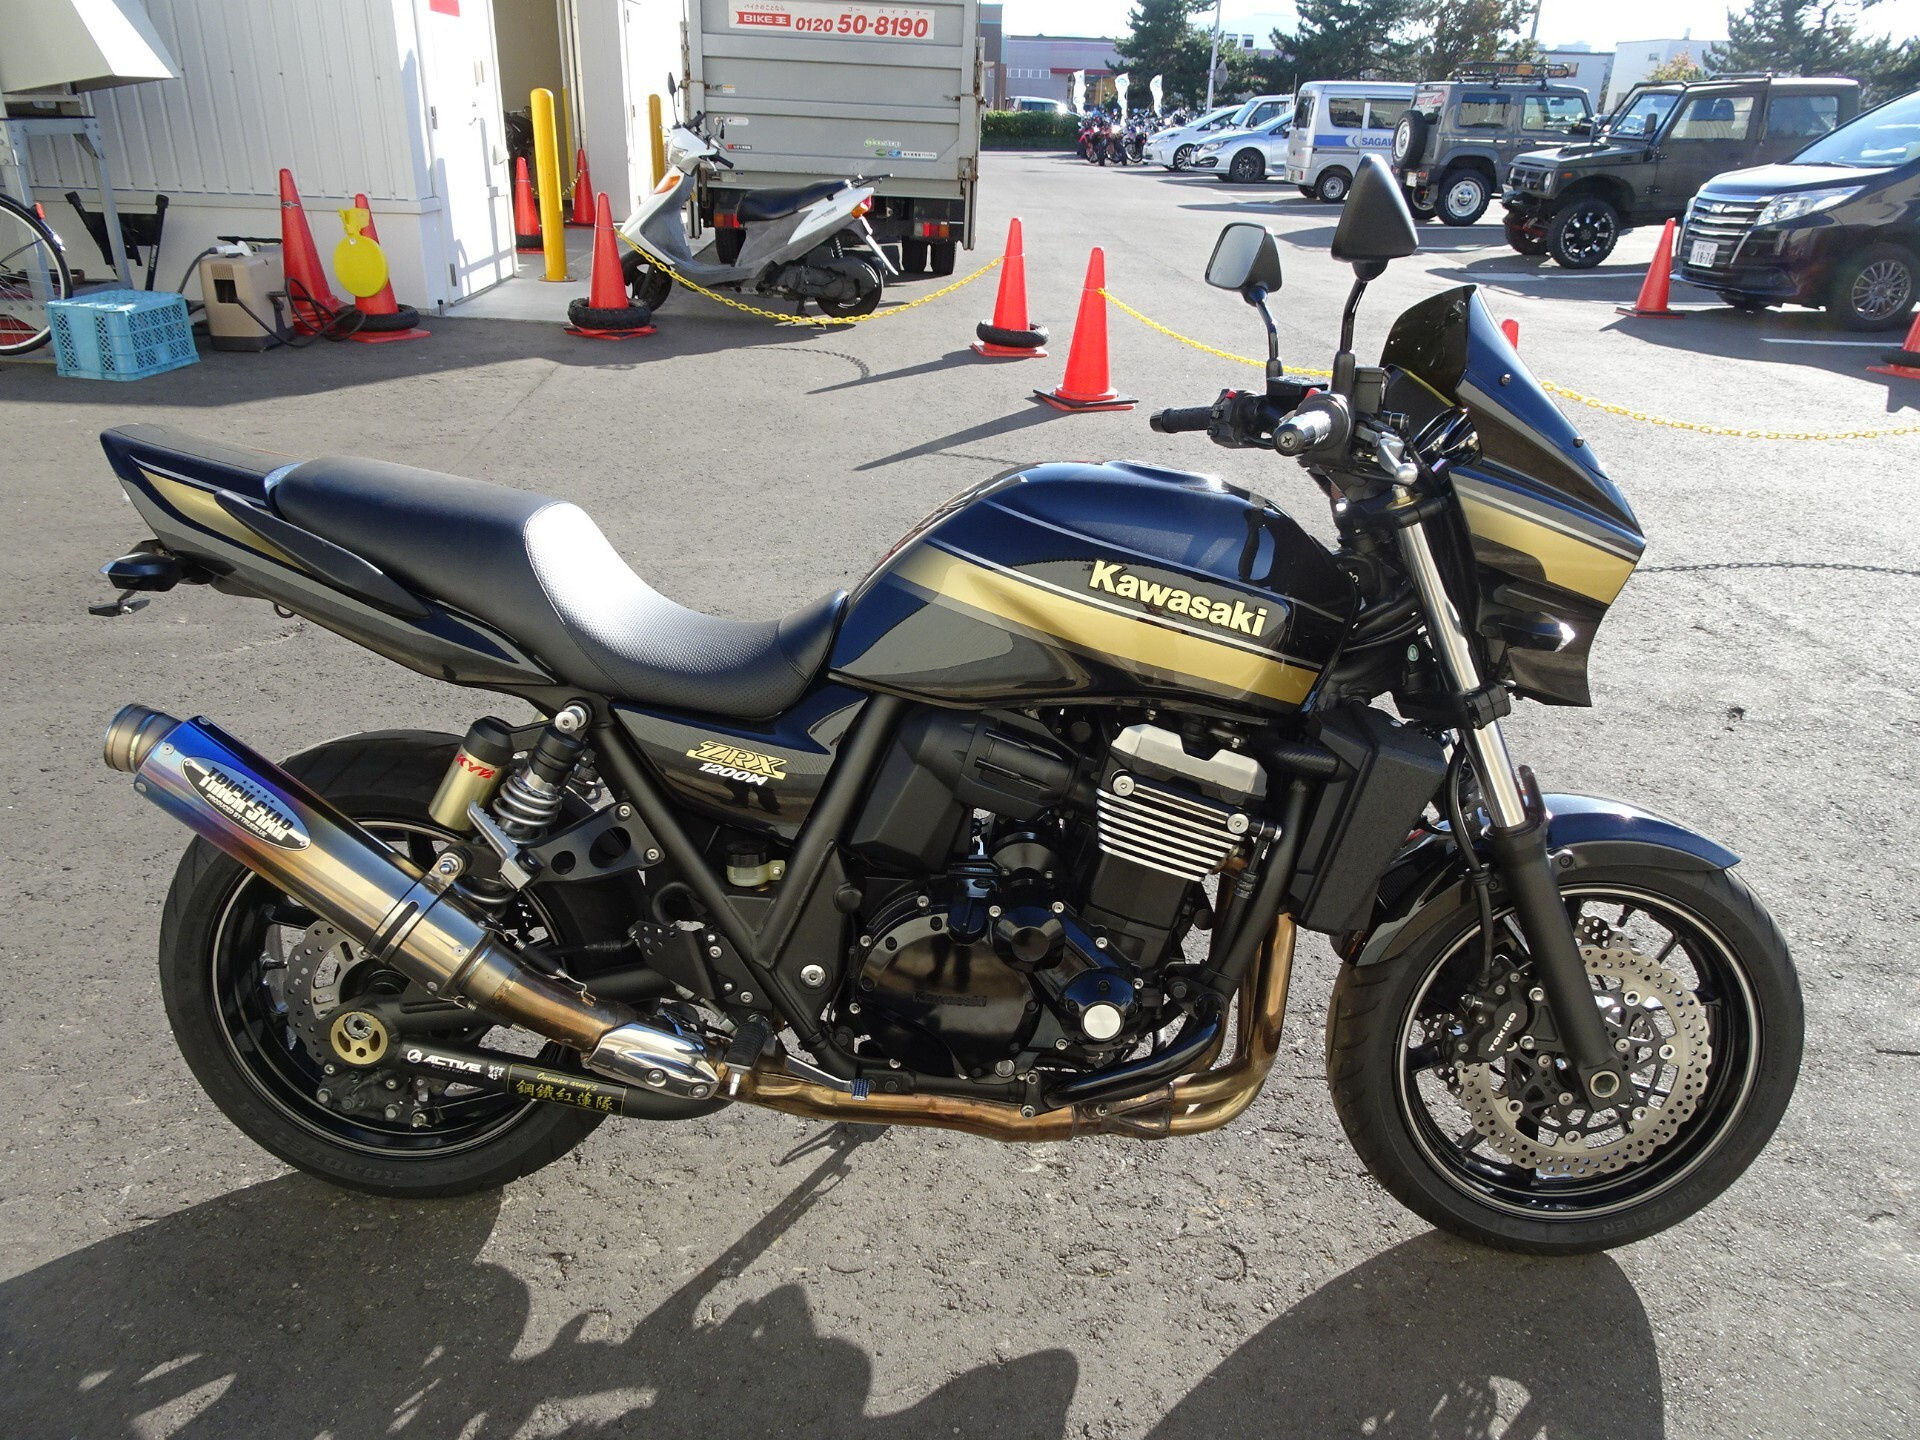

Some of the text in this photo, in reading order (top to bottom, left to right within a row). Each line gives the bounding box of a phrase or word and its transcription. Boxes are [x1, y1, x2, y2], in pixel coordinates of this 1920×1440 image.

[743, 14, 787, 25] BIKE 王
[795, 14, 929, 38] 0120 50-8190
[1089, 560, 1268, 637] Kawasaki
[456, 753, 496, 779] KYB
[687, 740, 787, 780] ZRX
[199, 766, 294, 841] TRICK STAR
[206, 793, 235, 815] PRODUCED
[1488, 1012, 1517, 1053] TOKICO
[423, 1055, 481, 1073] ACTIVE
[536, 1072, 600, 1092] Oneman army's
